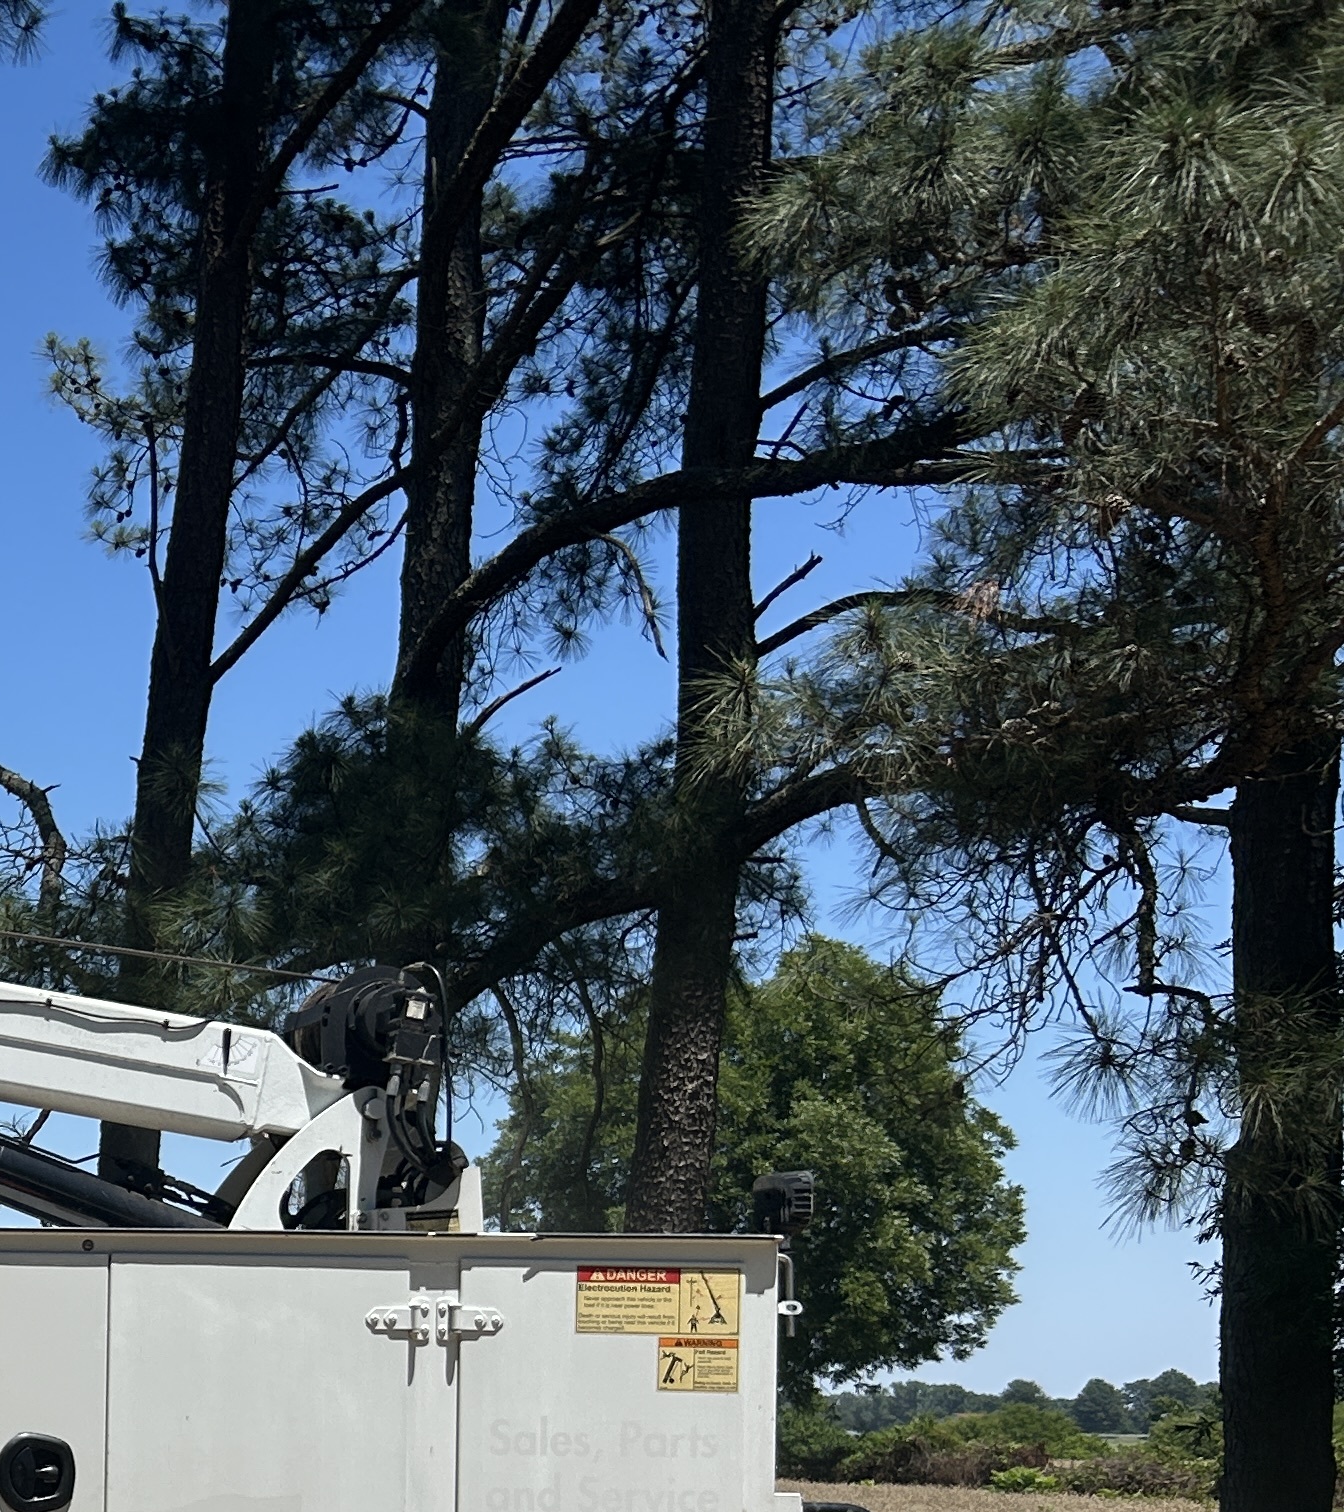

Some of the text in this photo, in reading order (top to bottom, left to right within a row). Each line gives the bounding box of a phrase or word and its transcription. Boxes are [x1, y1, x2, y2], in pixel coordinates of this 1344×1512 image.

[605, 1269, 667, 1281] DANGER
[578, 1284, 671, 1293] Electrocution Hazard
[489, 1415, 719, 1463] Sales, Parts
[485, 1472, 562, 1512] and
